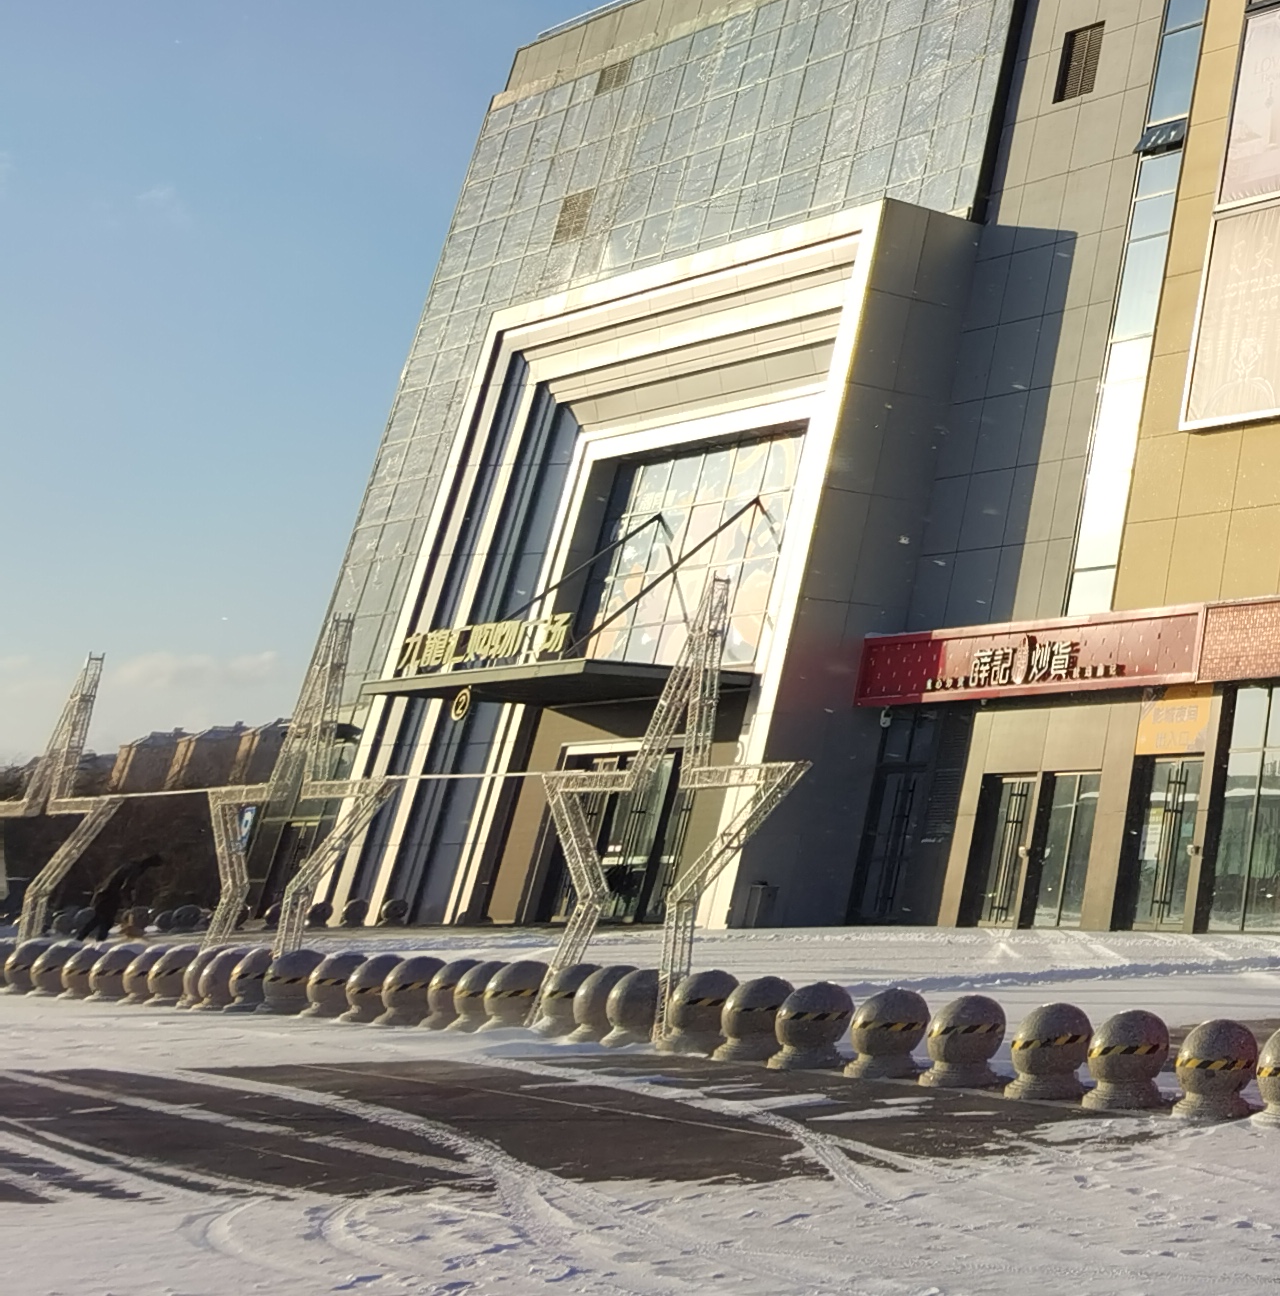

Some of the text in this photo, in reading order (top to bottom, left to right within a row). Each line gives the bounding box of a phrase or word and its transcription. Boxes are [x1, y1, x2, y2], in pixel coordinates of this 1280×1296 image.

[397, 612, 573, 670] 九龍汇购物广场
[1156, 731, 1190, 749] 出入口
